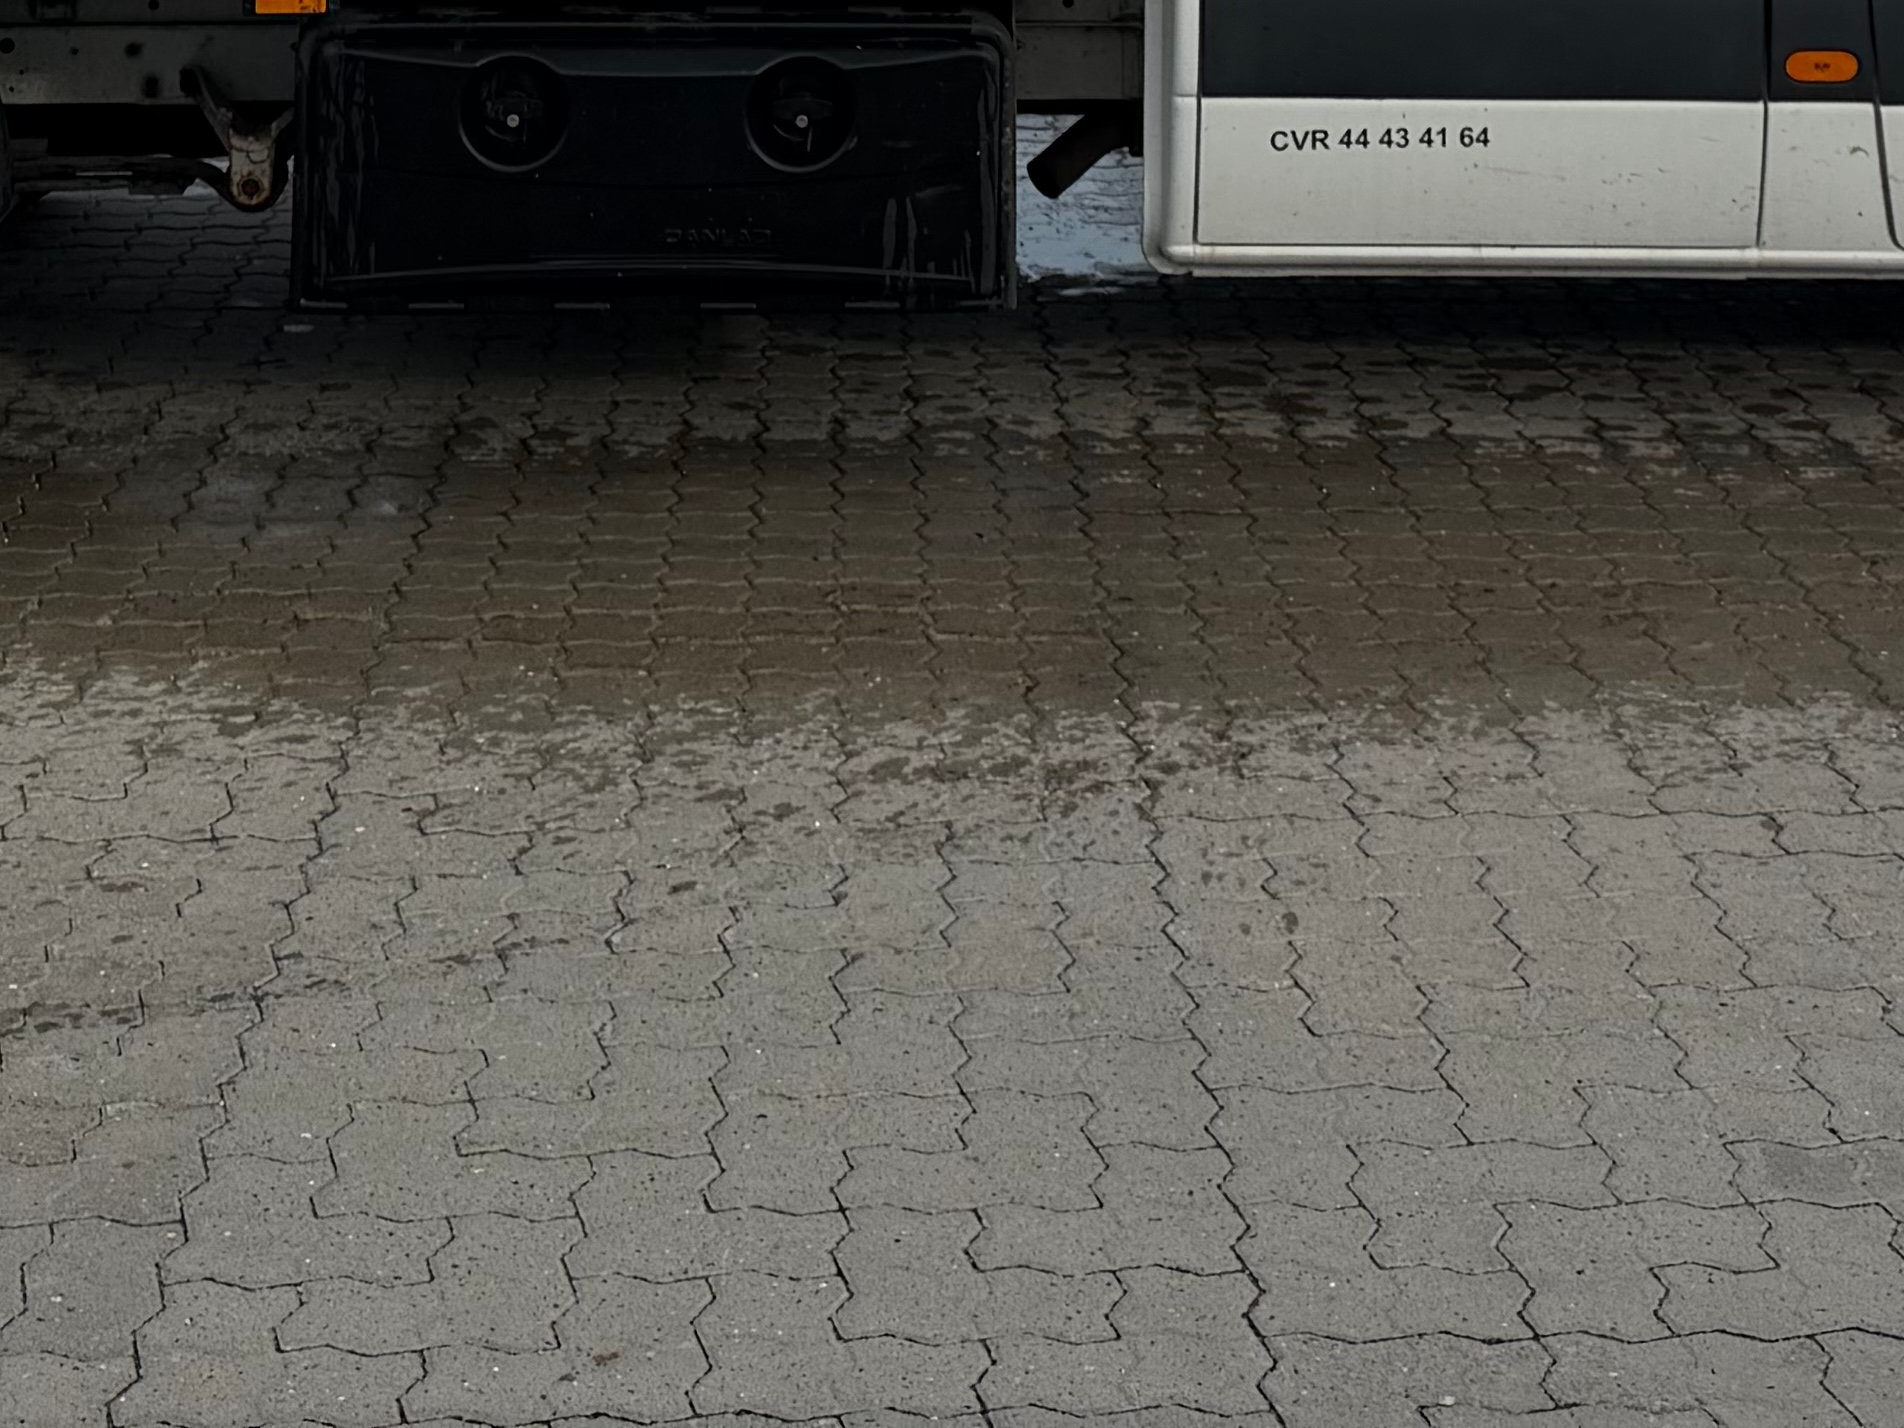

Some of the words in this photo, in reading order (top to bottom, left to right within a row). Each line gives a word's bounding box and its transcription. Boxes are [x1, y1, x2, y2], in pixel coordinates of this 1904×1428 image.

[1270, 130, 1330, 152] CVR
[1337, 129, 1370, 150] 44
[1378, 129, 1410, 150] 43
[1418, 128, 1449, 149] 41
[1458, 127, 1491, 149] 64
